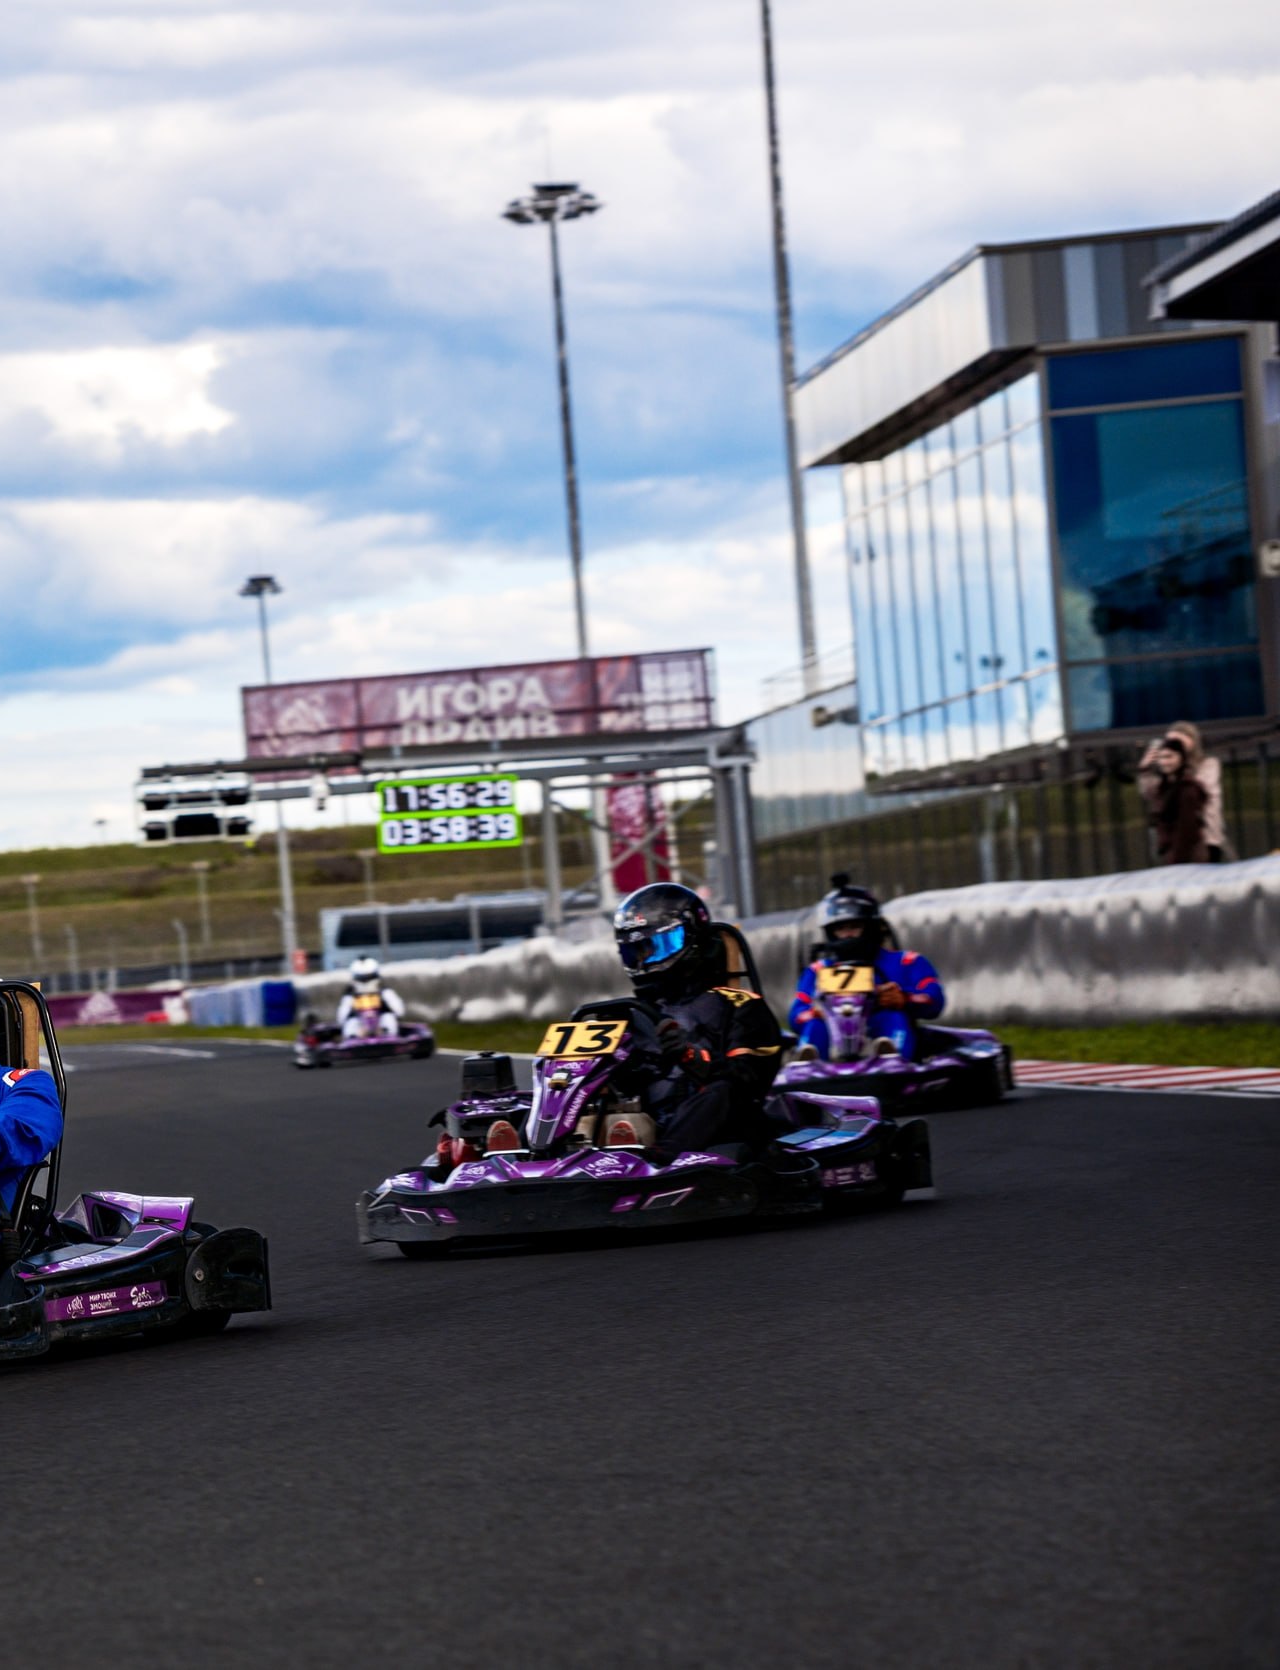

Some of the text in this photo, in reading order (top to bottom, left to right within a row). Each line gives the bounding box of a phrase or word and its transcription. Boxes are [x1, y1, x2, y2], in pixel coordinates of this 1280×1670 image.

[397, 677, 550, 718] ИГОРА
[384, 780, 515, 812] 17:56:29
[384, 813, 517, 846] 03:58:39
[833, 969, 856, 990] 7
[552, 1024, 618, 1055] 13
